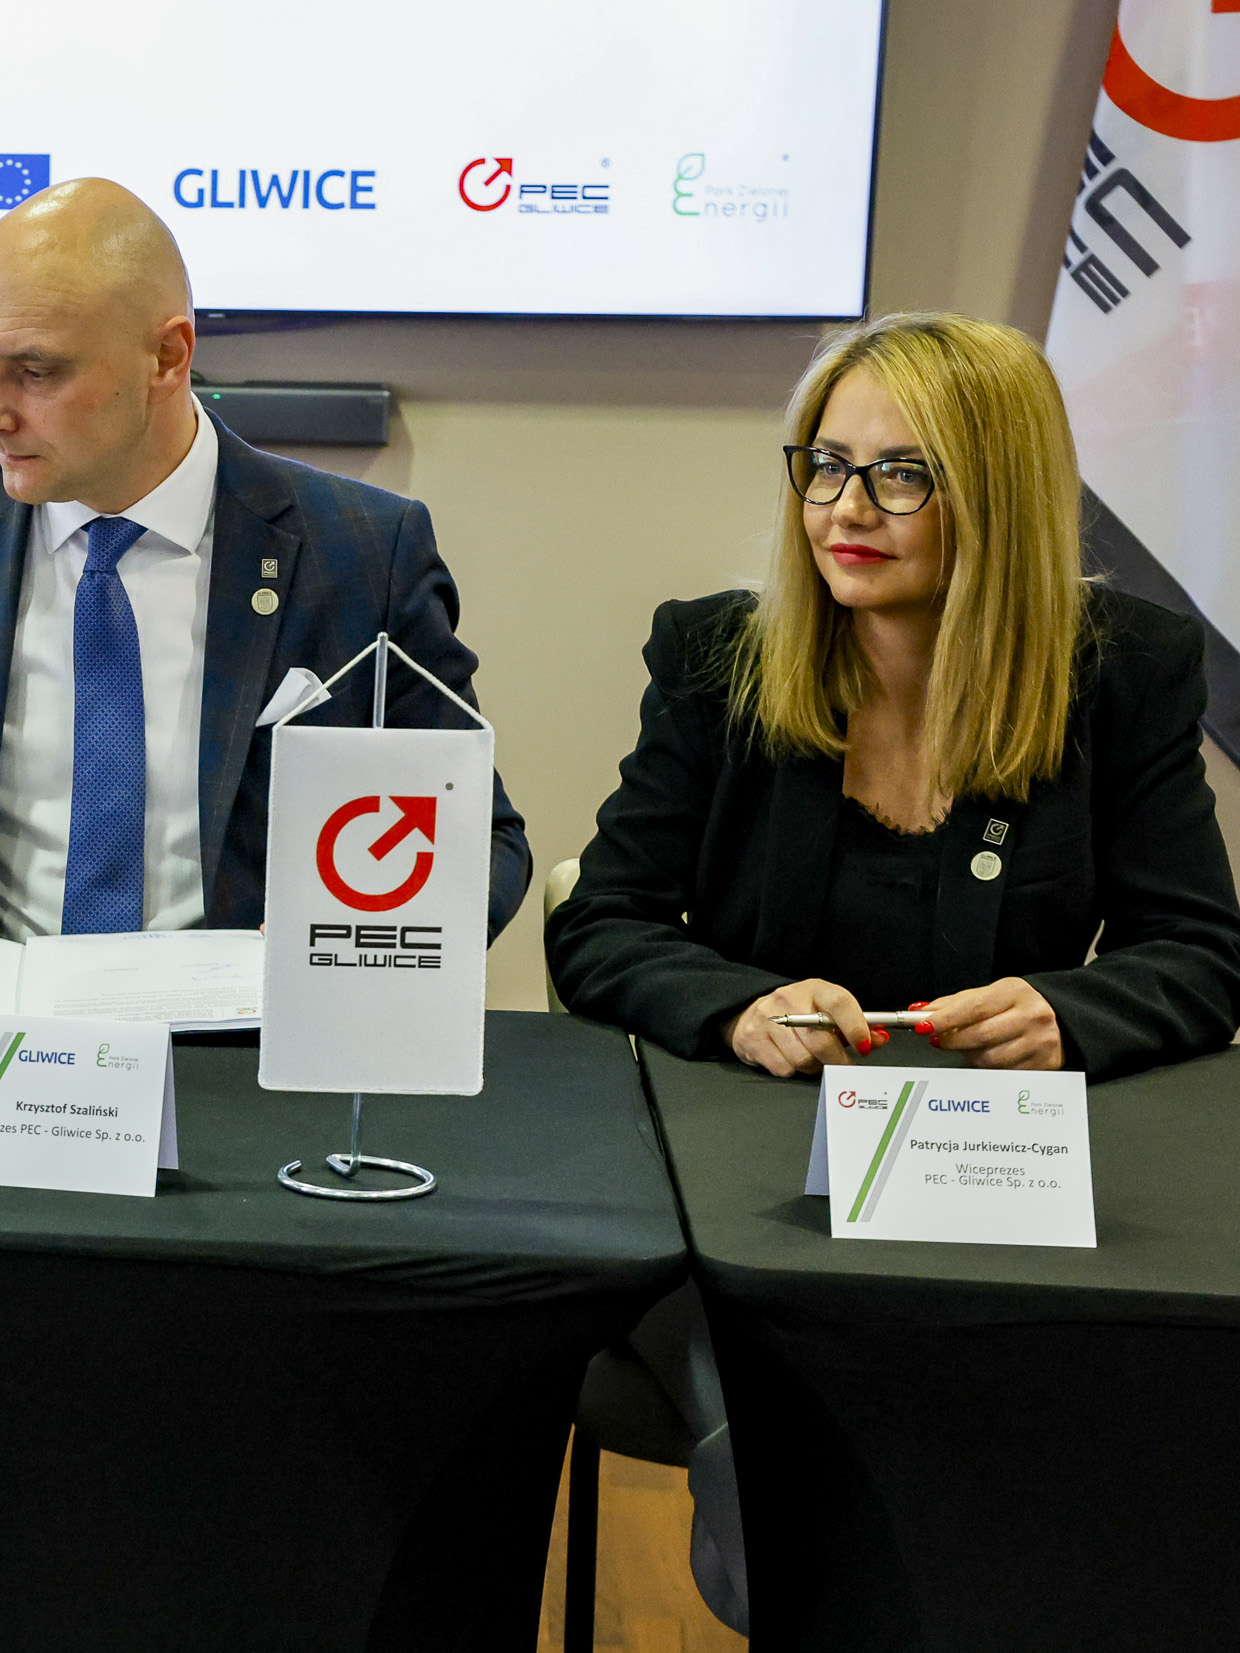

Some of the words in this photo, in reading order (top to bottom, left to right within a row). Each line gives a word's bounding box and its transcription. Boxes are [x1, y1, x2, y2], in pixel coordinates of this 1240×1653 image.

[173, 168, 376, 210] GLIWICE
[519, 184, 609, 200] PEC
[672, 174, 789, 223] Energii
[309, 923, 443, 950] PEC
[309, 953, 442, 969] GLIWICE
[18, 1049, 77, 1066] GLIWICE
[16, 1100, 68, 1115] Krzysztof
[69, 1104, 119, 1118] Szaliński
[928, 1099, 991, 1113] GLIWICE
[20, 1124, 42, 1136] PEC
[51, 1126, 92, 1139] Gliwice
[95, 1129, 112, 1142] Sp.
[115, 1132, 121, 1141] z
[123, 1133, 146, 1143] o.o.
[910, 1139, 959, 1153] Patrycja
[962, 1141, 1069, 1156] Jurkiewicz-Cygan
[955, 1163, 1026, 1178] Wiceprezes
[924, 1174, 948, 1185] PEC
[958, 1175, 1004, 1187] Gliwice
[1006, 1176, 1026, 1189] Sp.
[1028, 1179, 1035, 1188] z
[1037, 1179, 1062, 1189] o.o.
